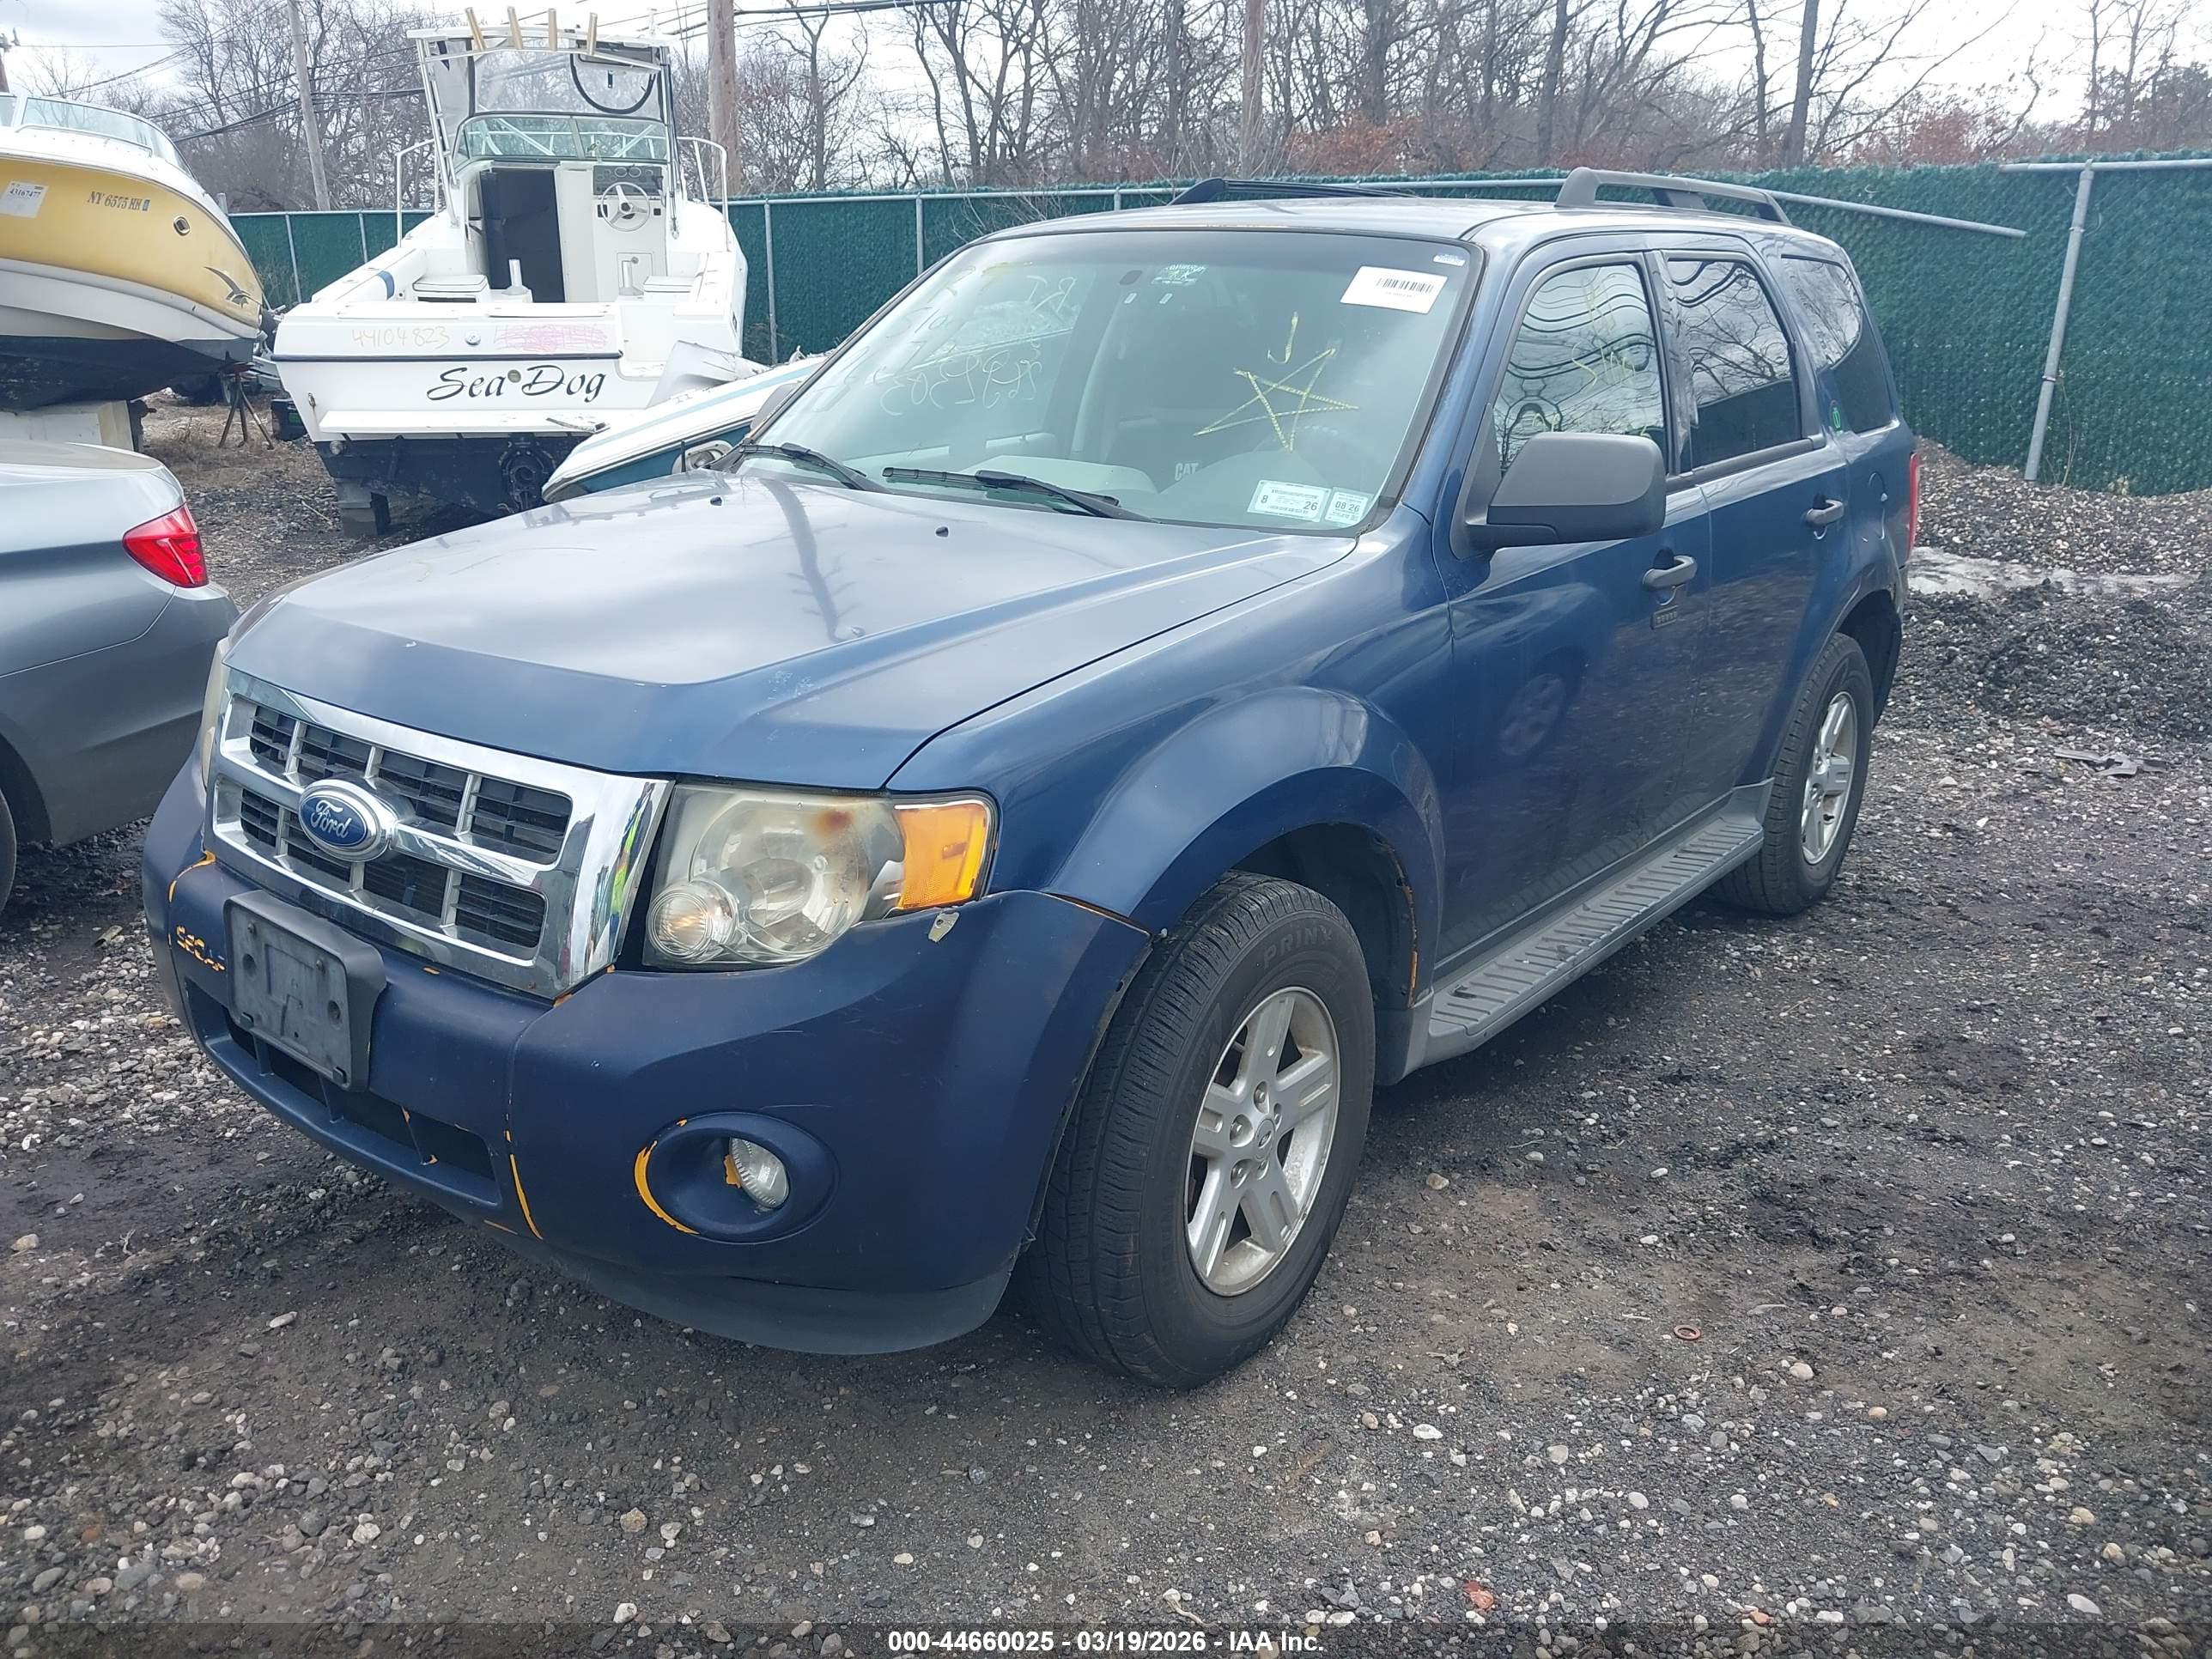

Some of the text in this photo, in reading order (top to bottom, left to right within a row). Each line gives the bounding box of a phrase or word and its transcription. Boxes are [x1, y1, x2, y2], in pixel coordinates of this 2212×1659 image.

[87, 191, 105, 204] NY
[104, 194, 129, 209] 6575
[427, 365, 606, 403] Sea Dog
[1174, 462, 1200, 482] CAT
[1260, 495, 1268, 503] 8
[1303, 501, 1318, 511] 26
[1334, 501, 1360, 513] 08 26
[310, 799, 352, 839] Ford
